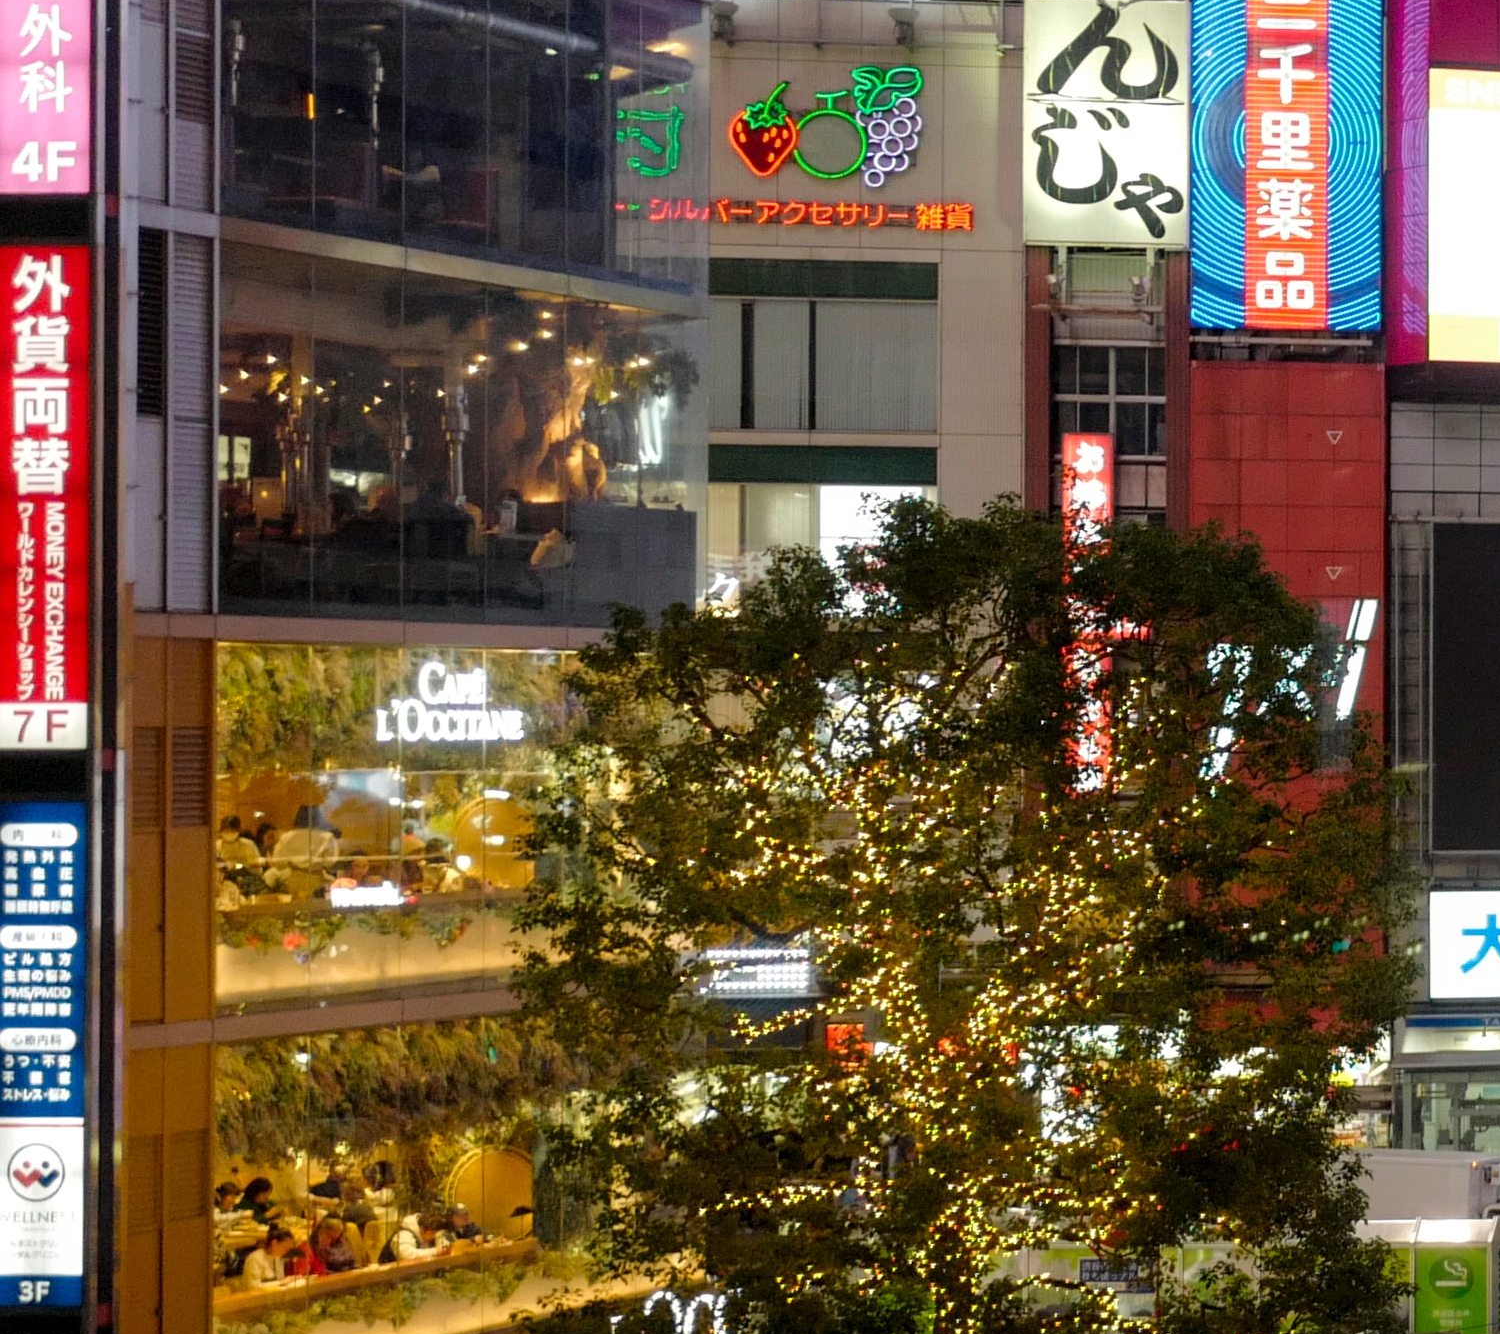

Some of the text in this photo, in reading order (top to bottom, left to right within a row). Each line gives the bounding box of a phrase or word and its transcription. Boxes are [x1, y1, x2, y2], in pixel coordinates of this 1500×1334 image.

[12, 140, 77, 183] 4F
[916, 202, 973, 231] 雑貨
[12, 254, 70, 496] 外貨両替
[45, 501, 65, 701] MONEY EXCHANGE
[13, 709, 70, 744] 7F
[18, 1281, 51, 1303] 3F
